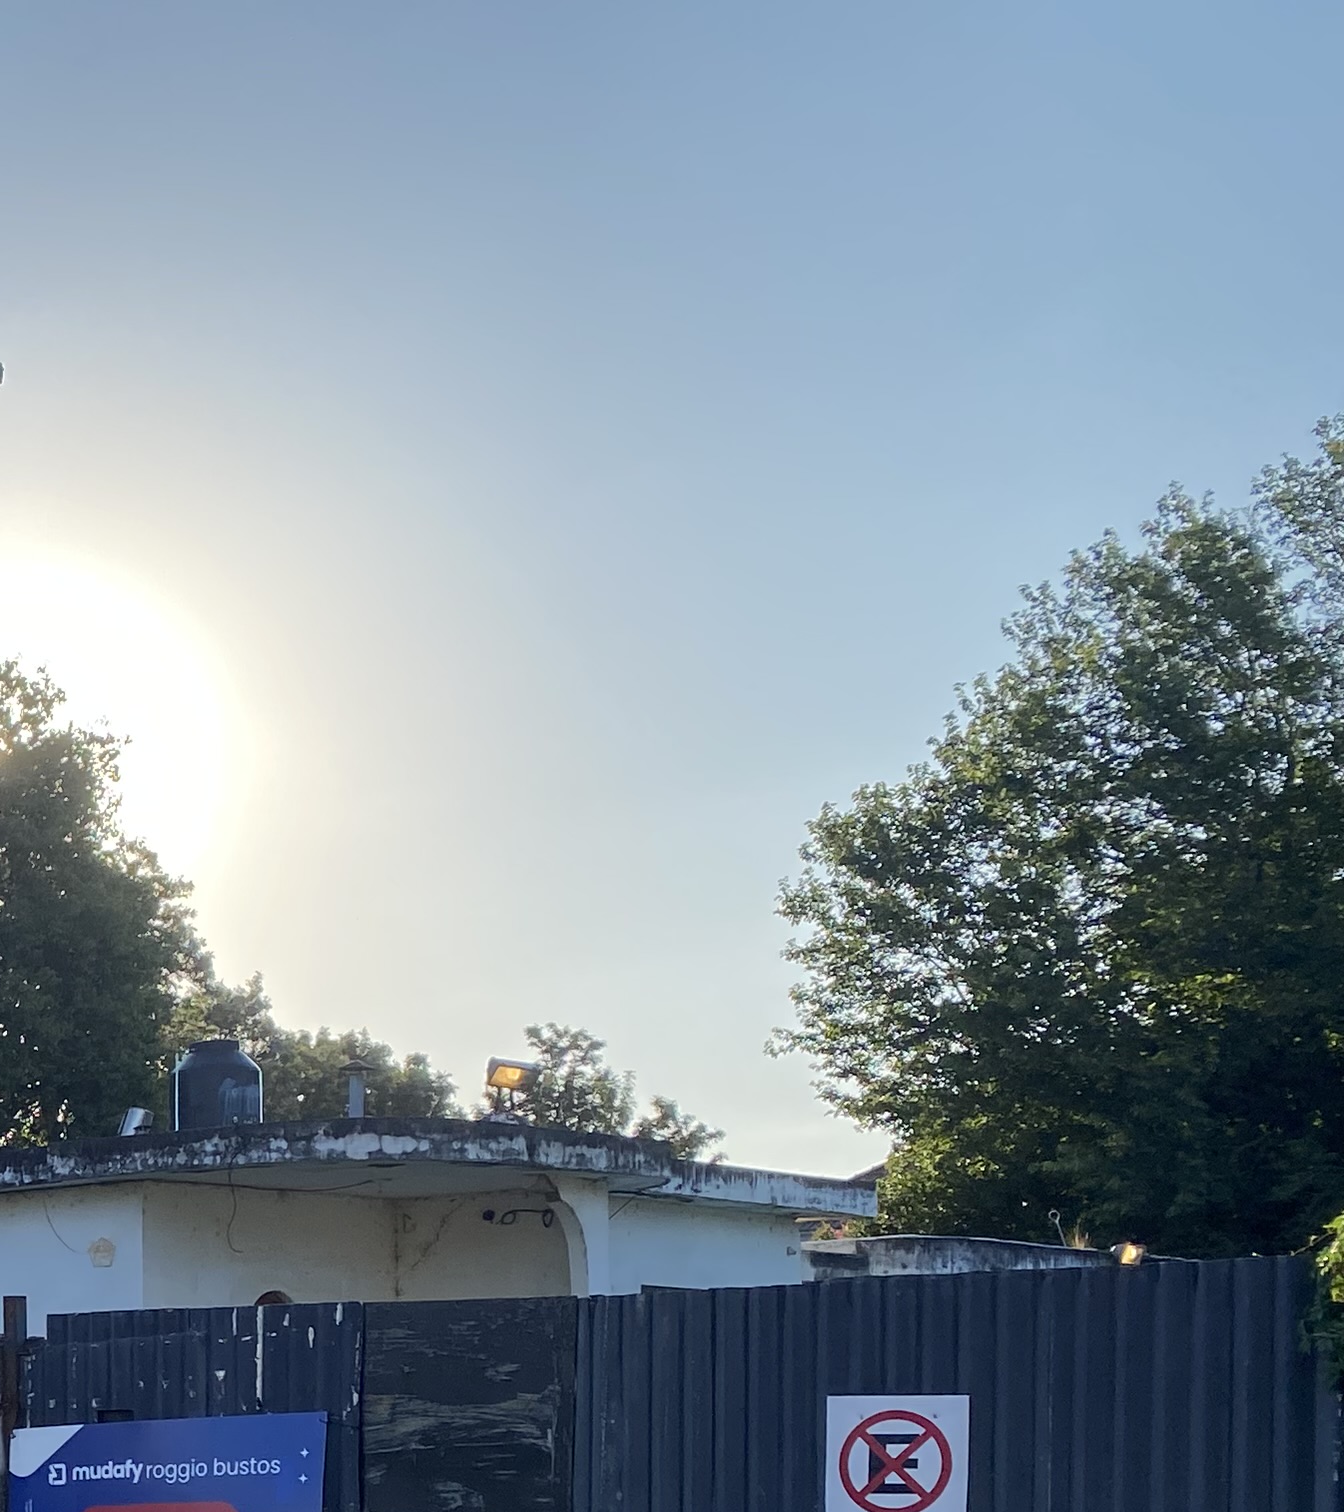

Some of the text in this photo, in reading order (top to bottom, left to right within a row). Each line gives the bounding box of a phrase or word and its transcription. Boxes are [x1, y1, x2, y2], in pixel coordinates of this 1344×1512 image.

[72, 1457, 281, 1484] mudafy roggio bustos
